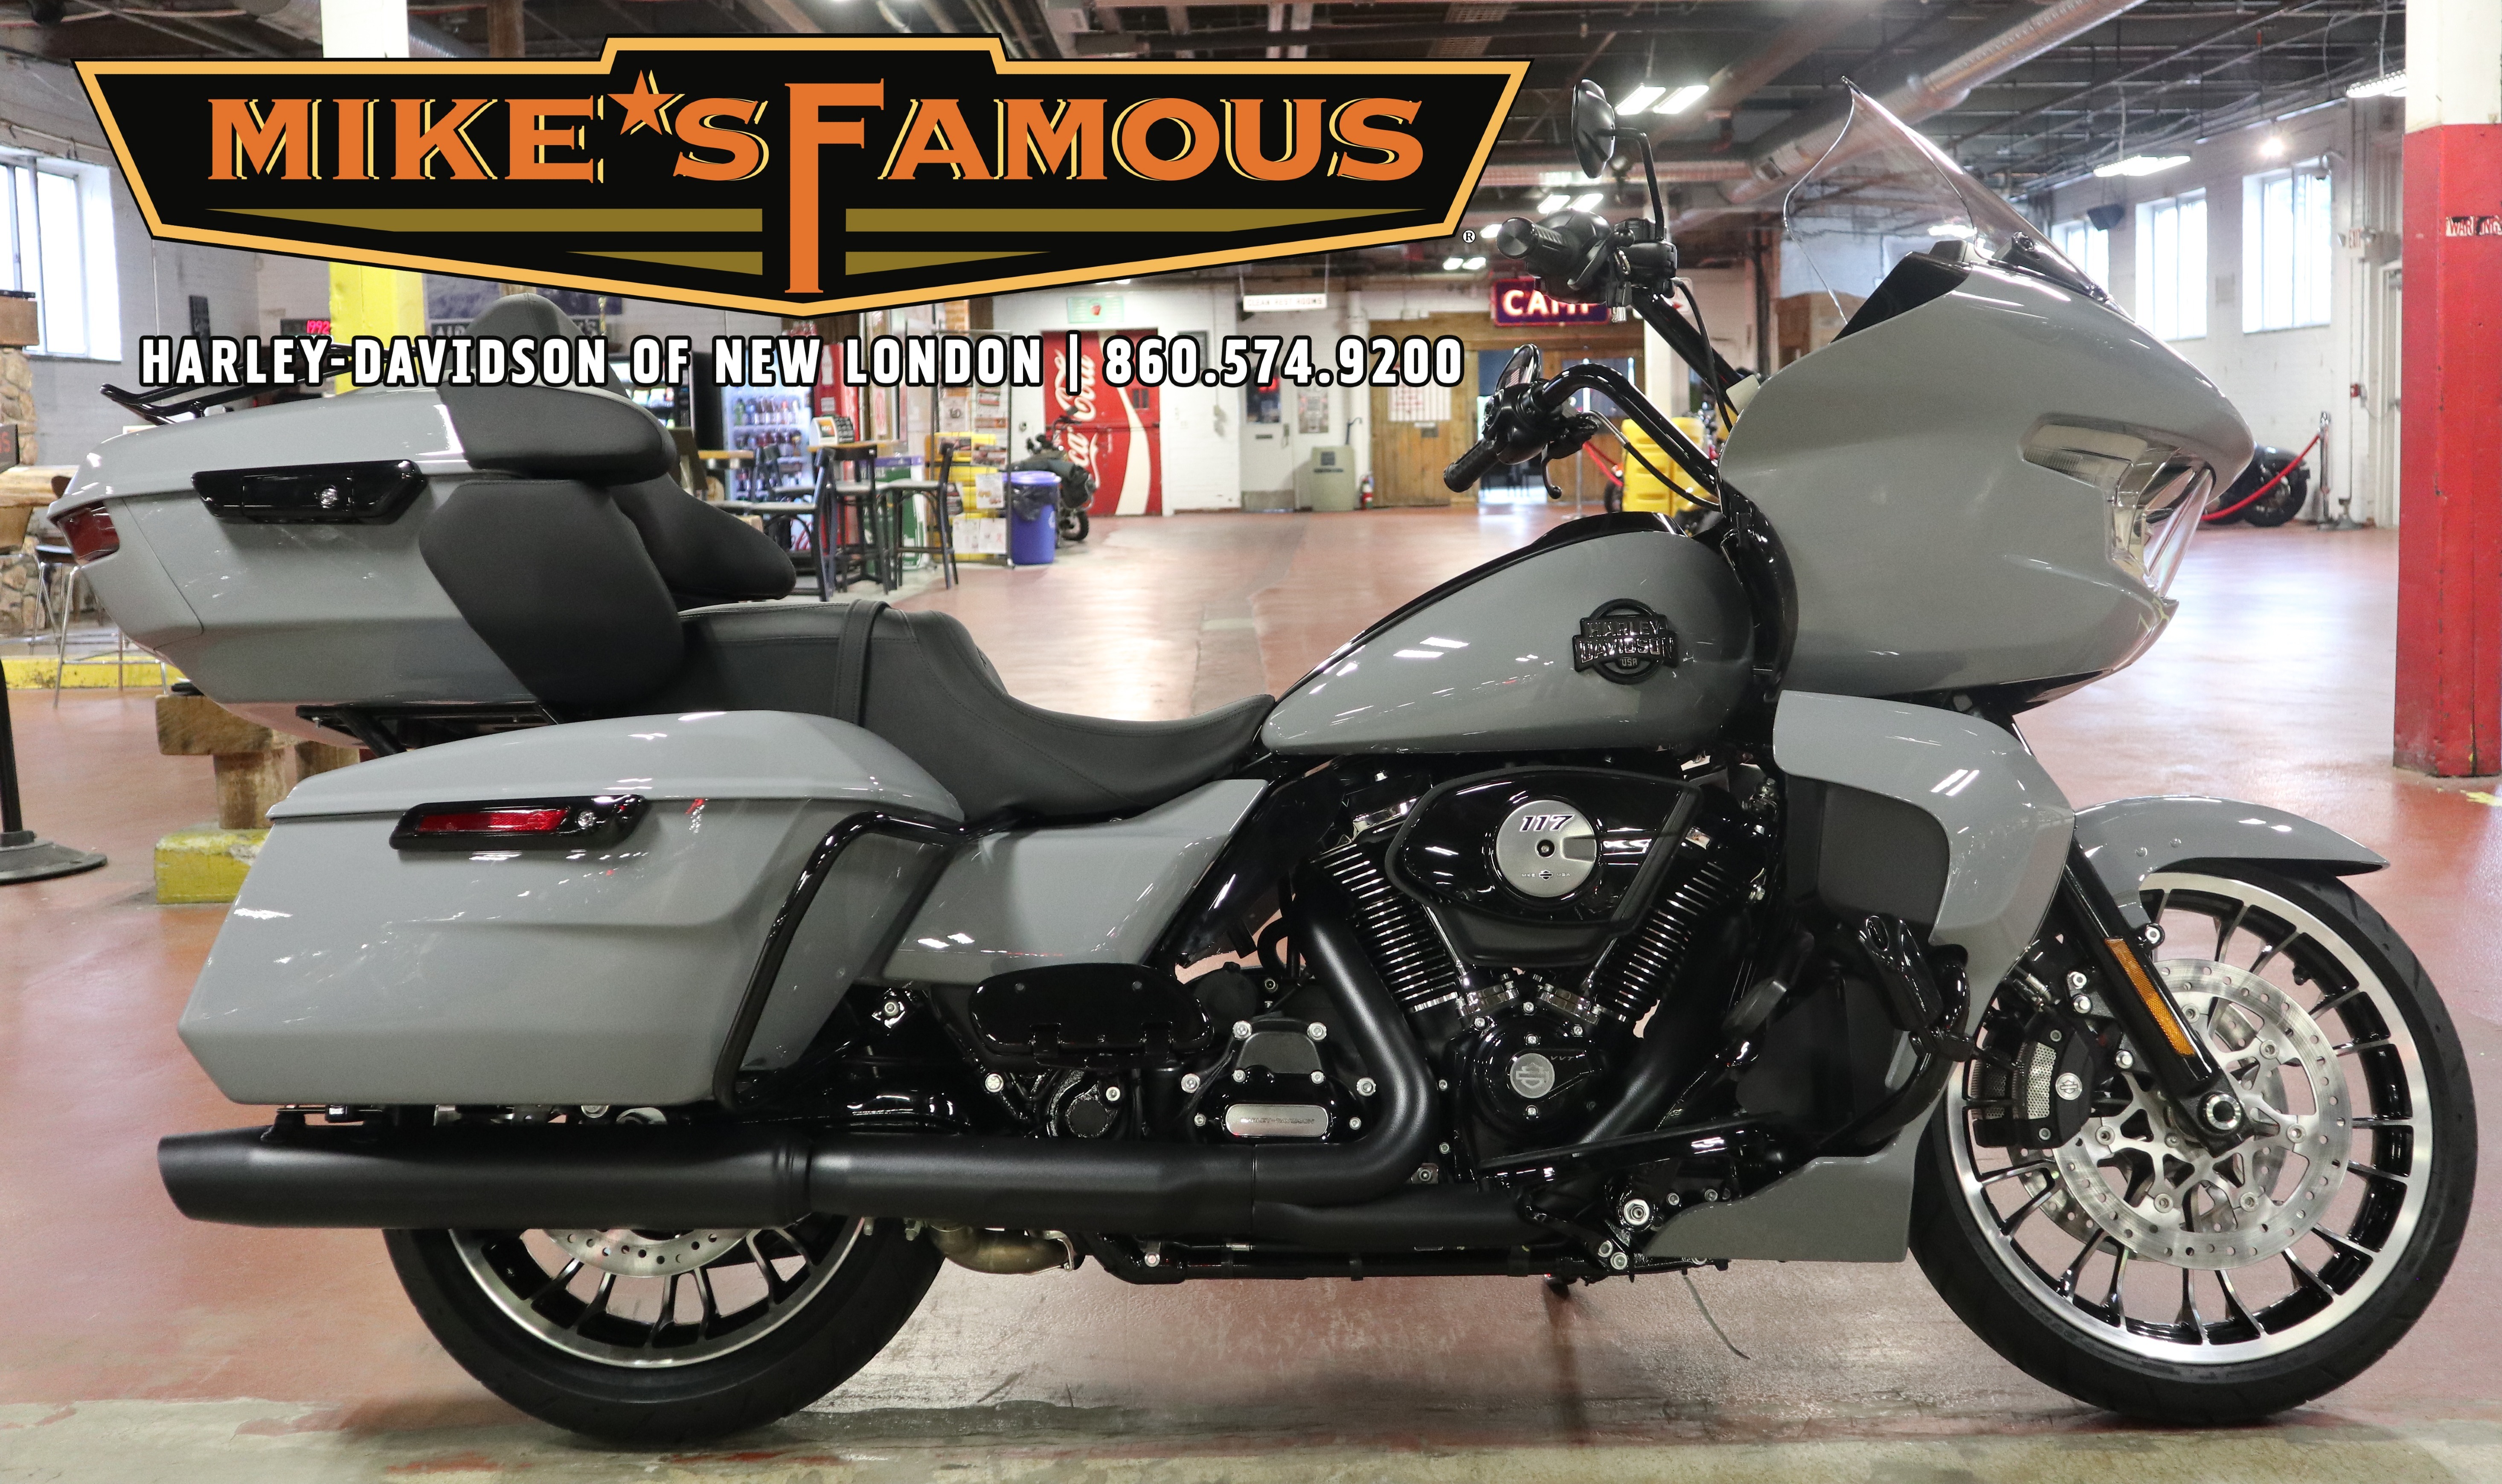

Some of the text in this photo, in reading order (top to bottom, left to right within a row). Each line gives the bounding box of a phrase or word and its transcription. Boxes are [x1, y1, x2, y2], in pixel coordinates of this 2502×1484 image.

[1579, 637, 1674, 663] DAVIDSON
[1622, 658, 1638, 666] USA
[1519, 814, 1575, 832] 117
